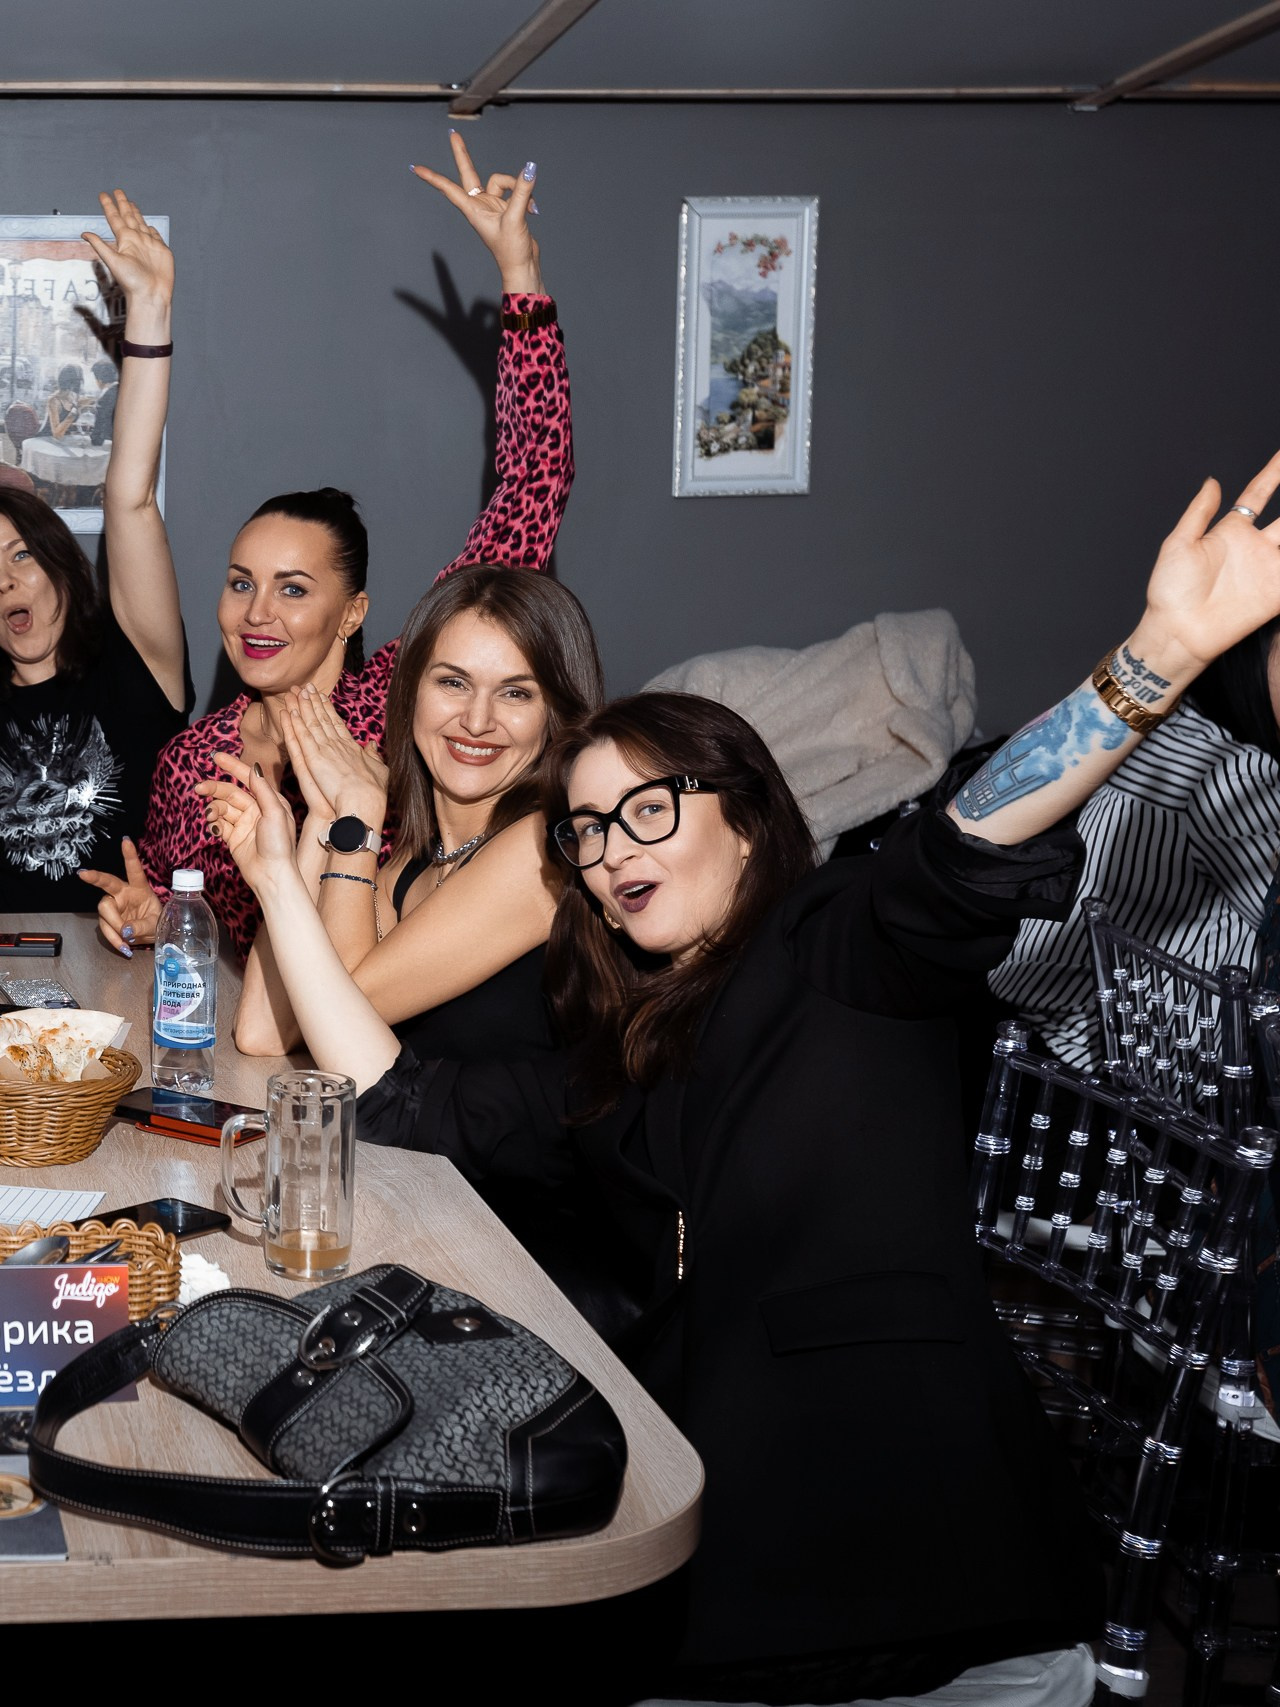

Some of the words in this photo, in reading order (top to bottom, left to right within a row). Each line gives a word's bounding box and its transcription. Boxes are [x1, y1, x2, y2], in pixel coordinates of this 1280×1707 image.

[163, 981, 207, 989] ПРИРОДНАЯ
[163, 990, 200, 998] ПИТЬЕВАЯ
[52, 1270, 120, 1310] Indigo
